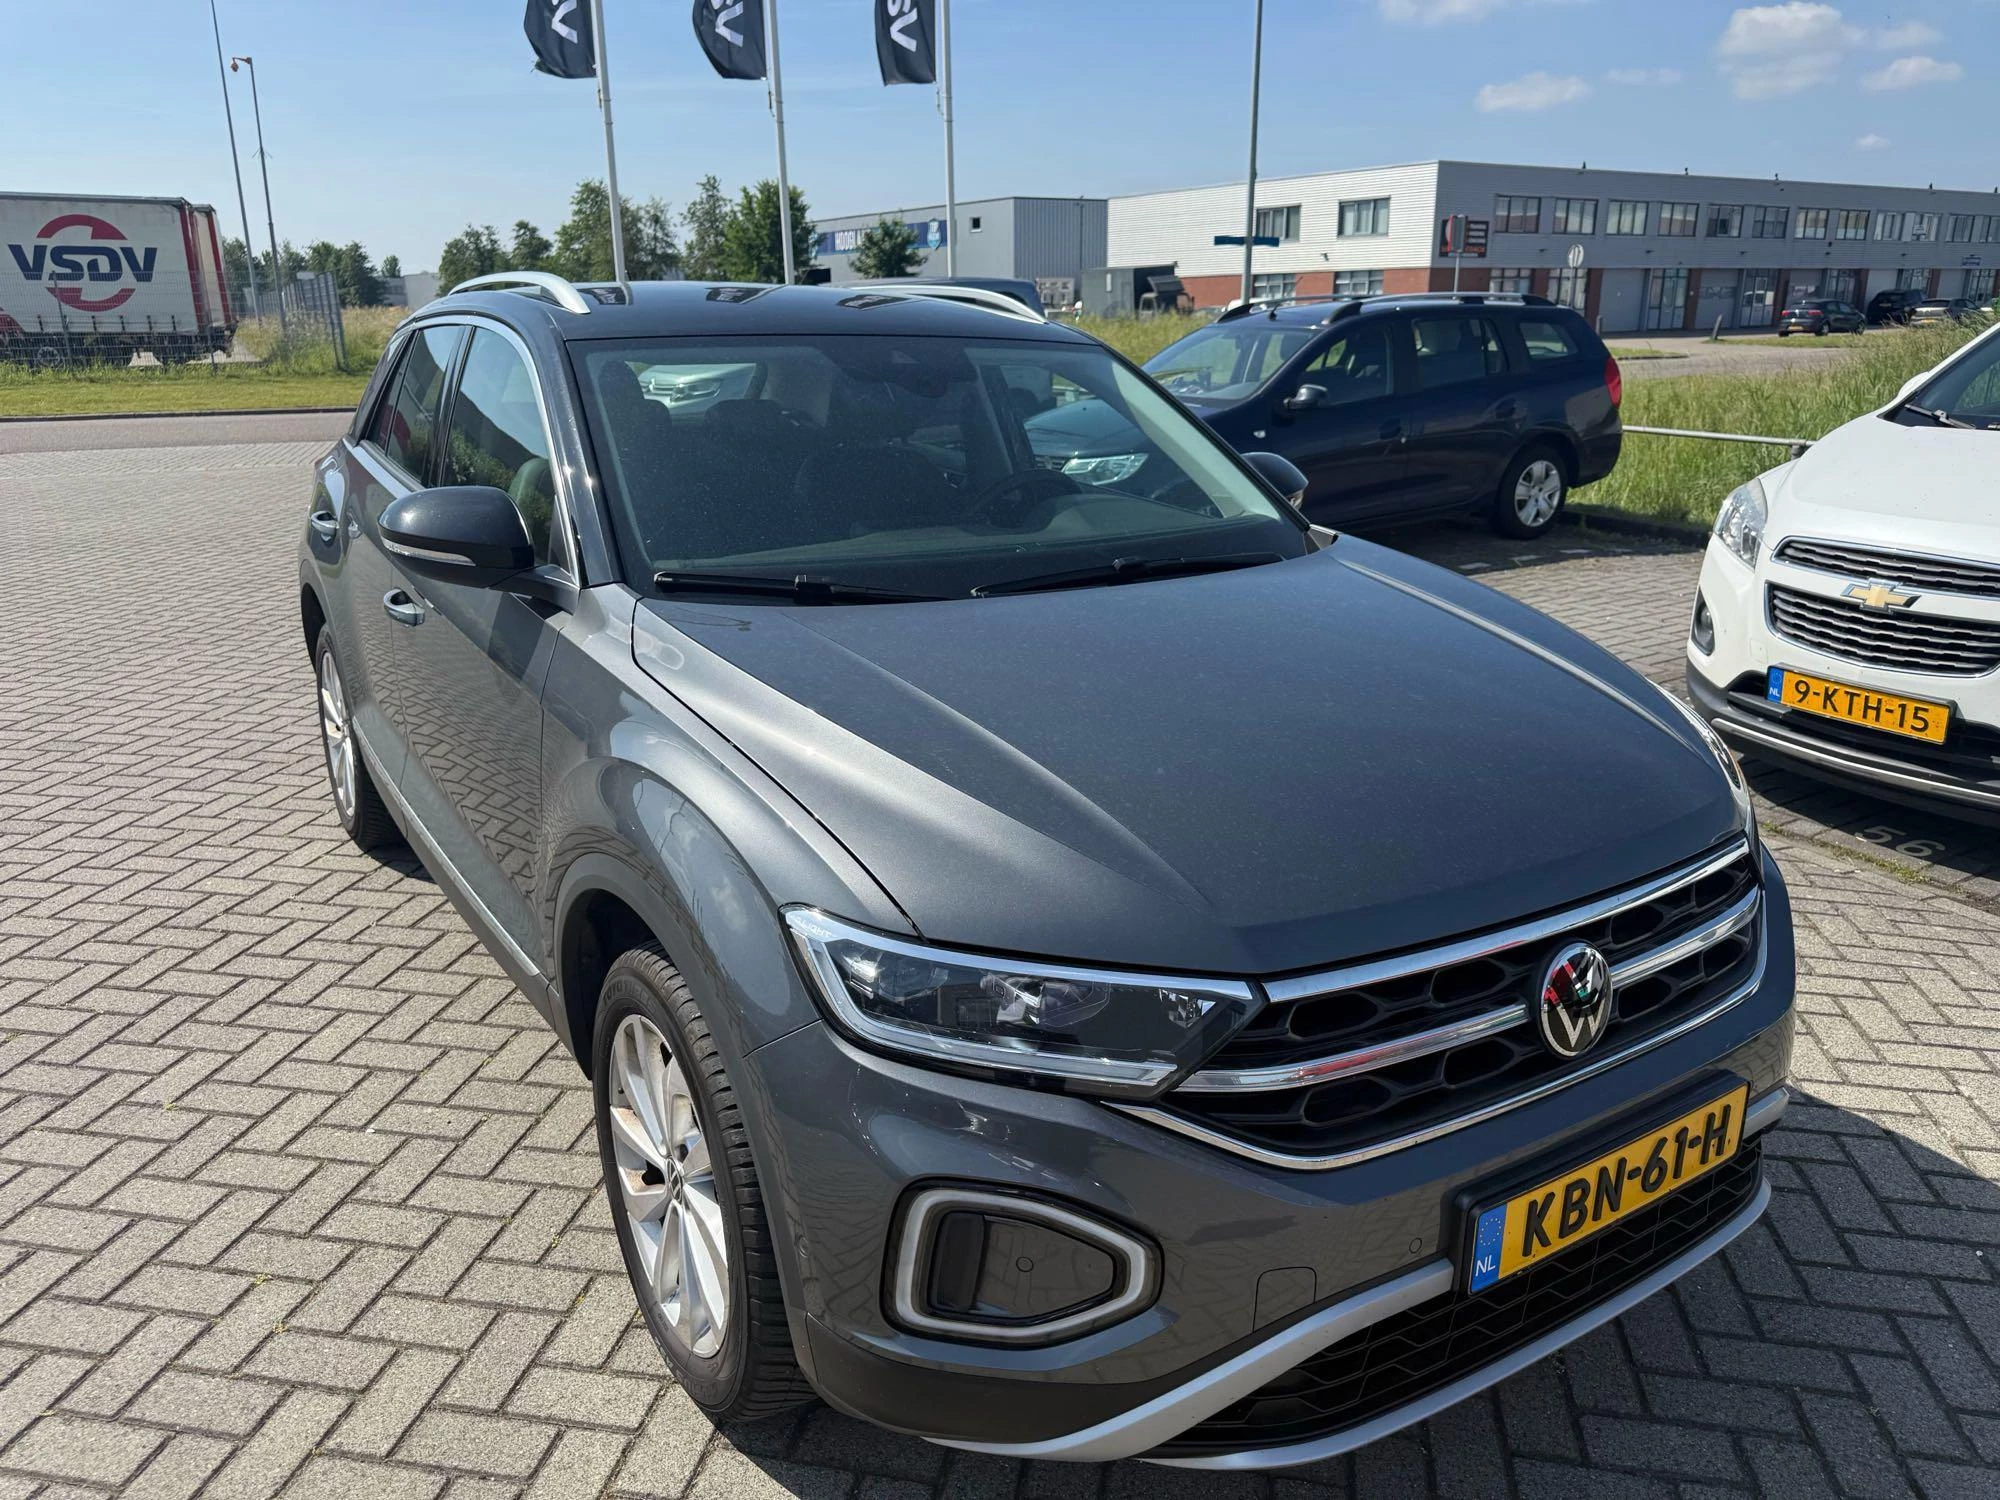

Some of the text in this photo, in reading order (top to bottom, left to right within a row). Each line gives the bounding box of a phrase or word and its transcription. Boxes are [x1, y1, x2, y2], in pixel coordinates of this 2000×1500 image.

[8, 244, 157, 282] VSDV
[1769, 679, 1929, 733] NL 9-KTH-15
[1475, 1104, 1732, 1277] NL KBN-61-H
